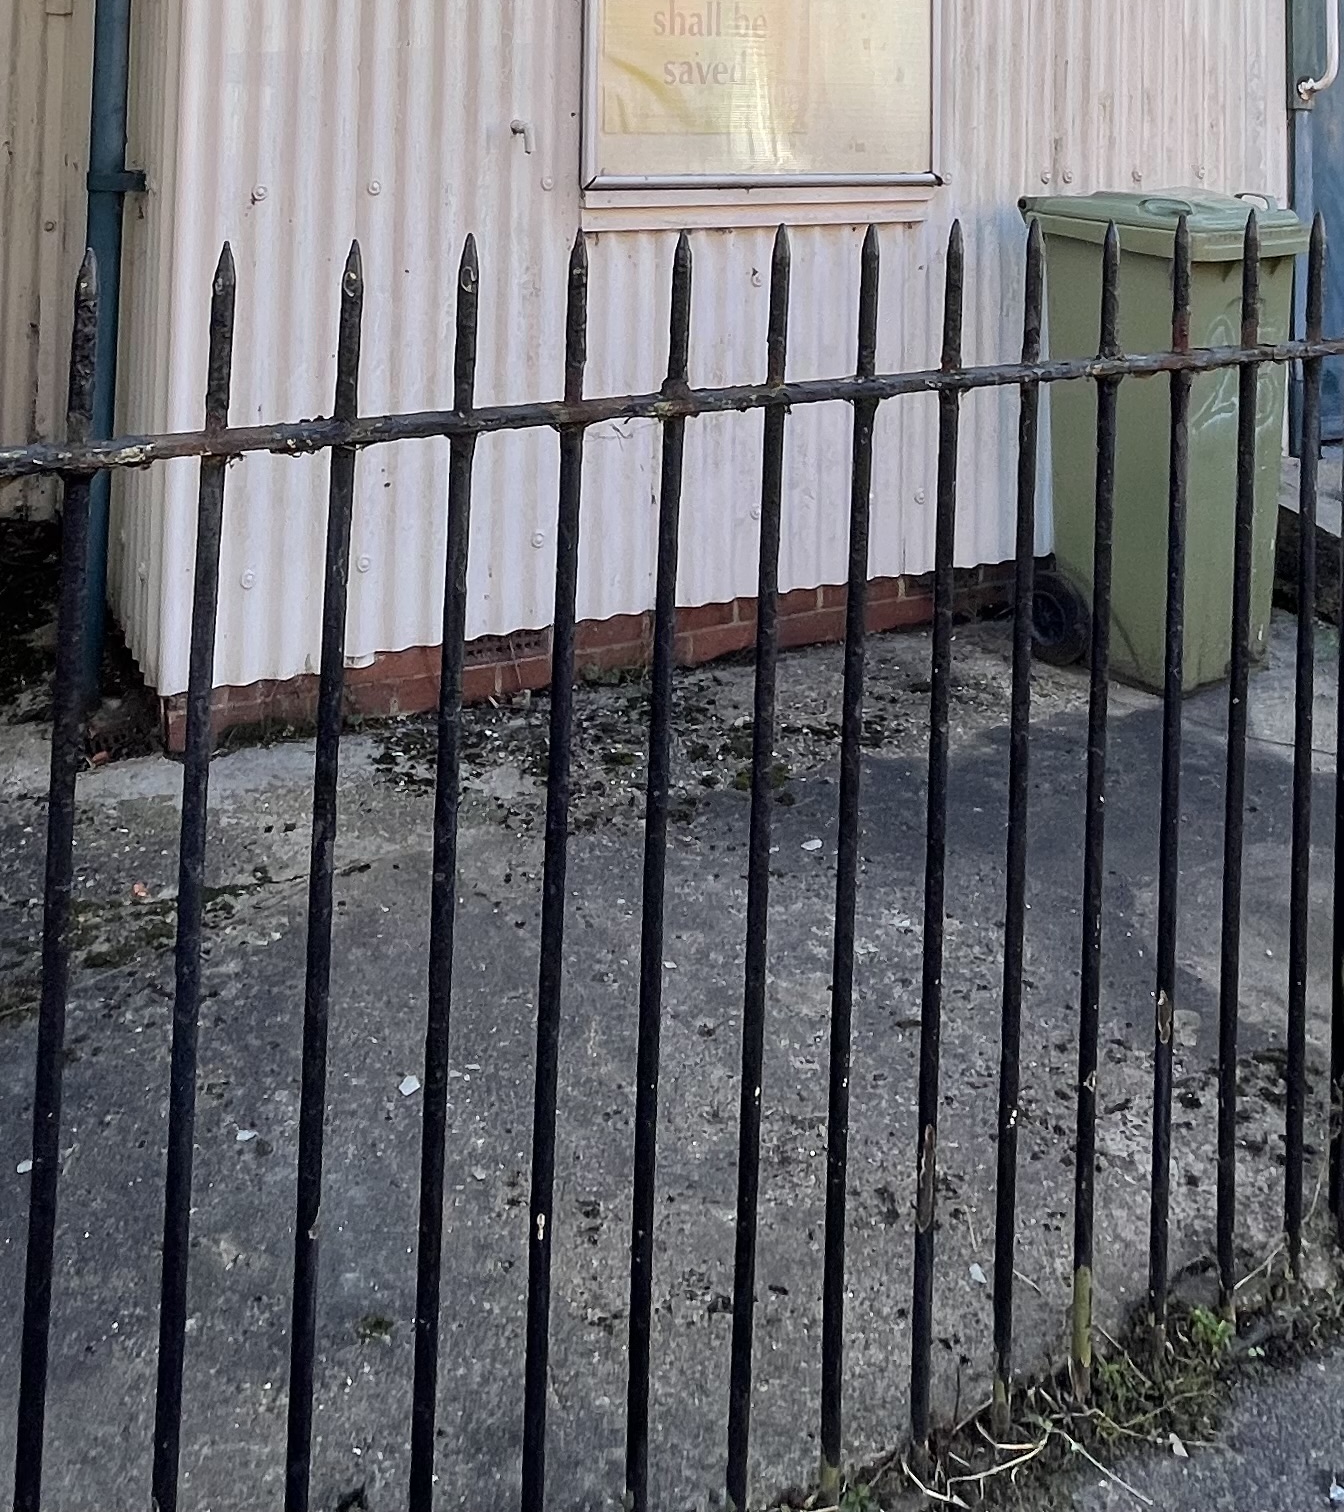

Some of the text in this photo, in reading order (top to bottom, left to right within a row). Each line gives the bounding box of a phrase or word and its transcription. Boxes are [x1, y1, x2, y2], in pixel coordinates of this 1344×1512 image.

[653, 0, 768, 39] shall be
[663, 50, 747, 85] saved
